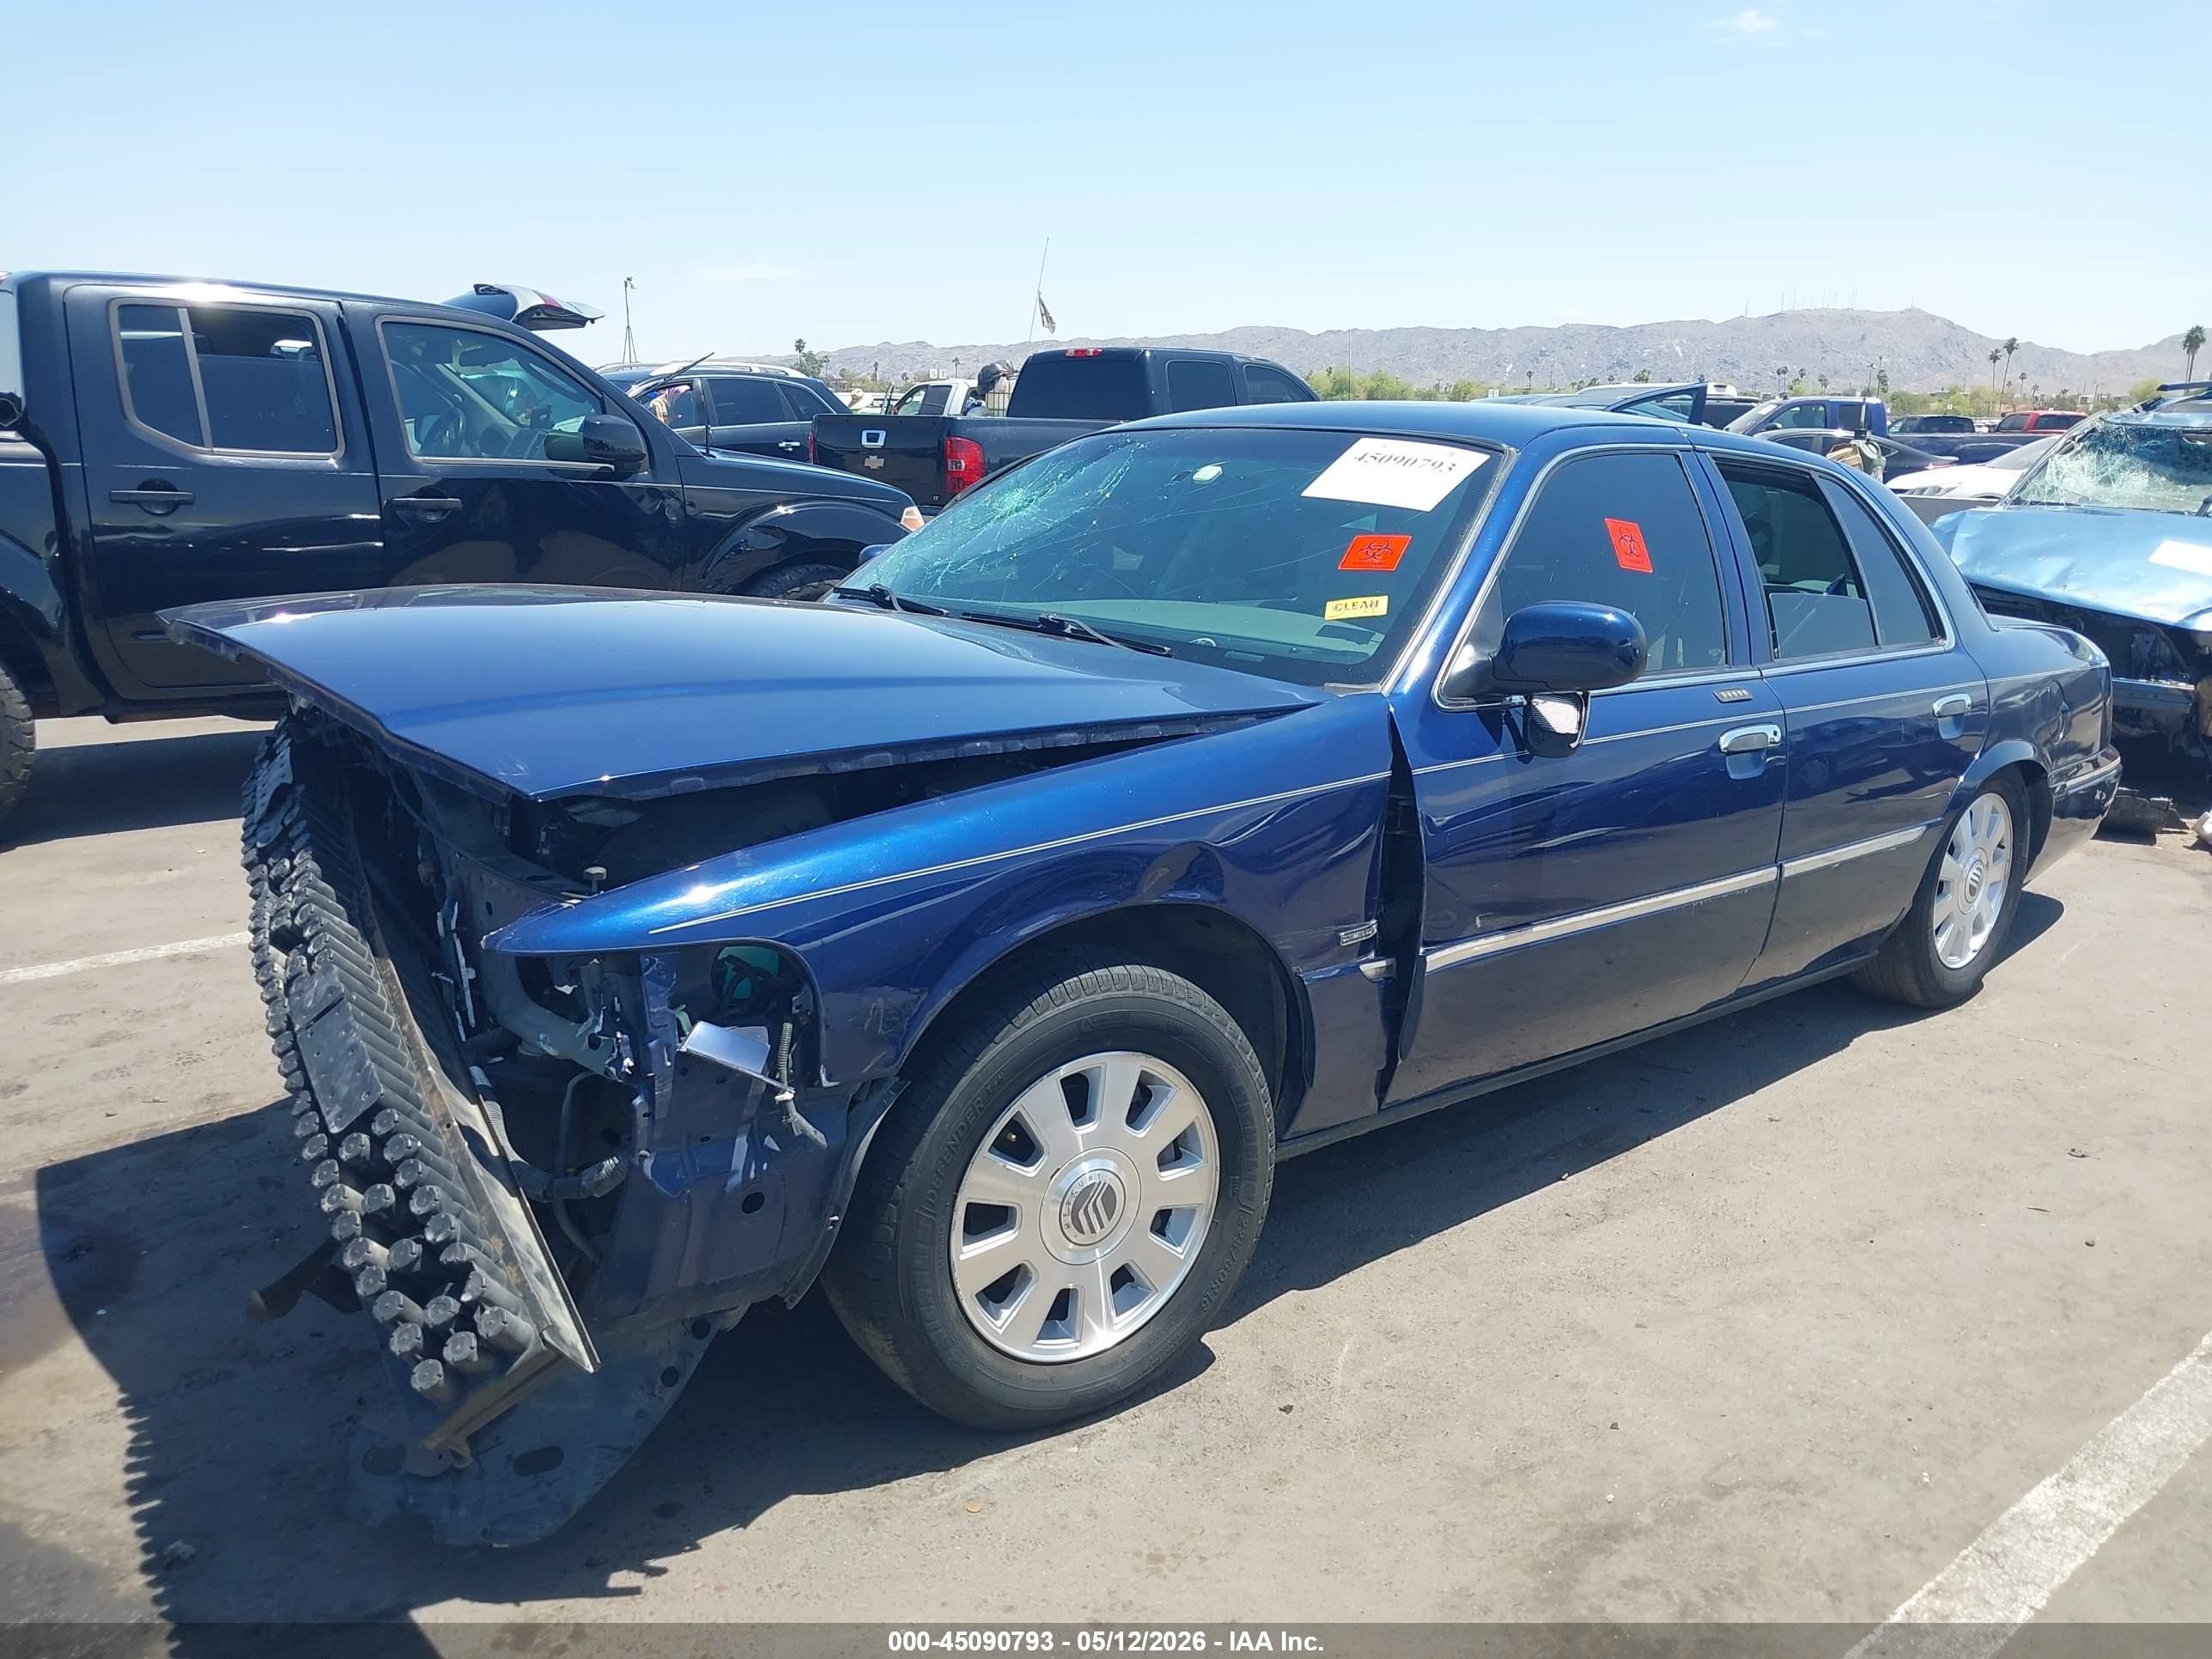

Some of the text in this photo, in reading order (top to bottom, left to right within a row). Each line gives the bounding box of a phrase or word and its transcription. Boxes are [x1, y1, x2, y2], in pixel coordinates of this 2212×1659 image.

[1354, 452, 1456, 472] 45090793
[1334, 599, 1379, 612] CLEAN
[922, 1094, 987, 1204] DEFENDER
[1062, 1172, 1103, 1231] MERCURY
[1200, 1215, 1249, 1314] 225/60R16
